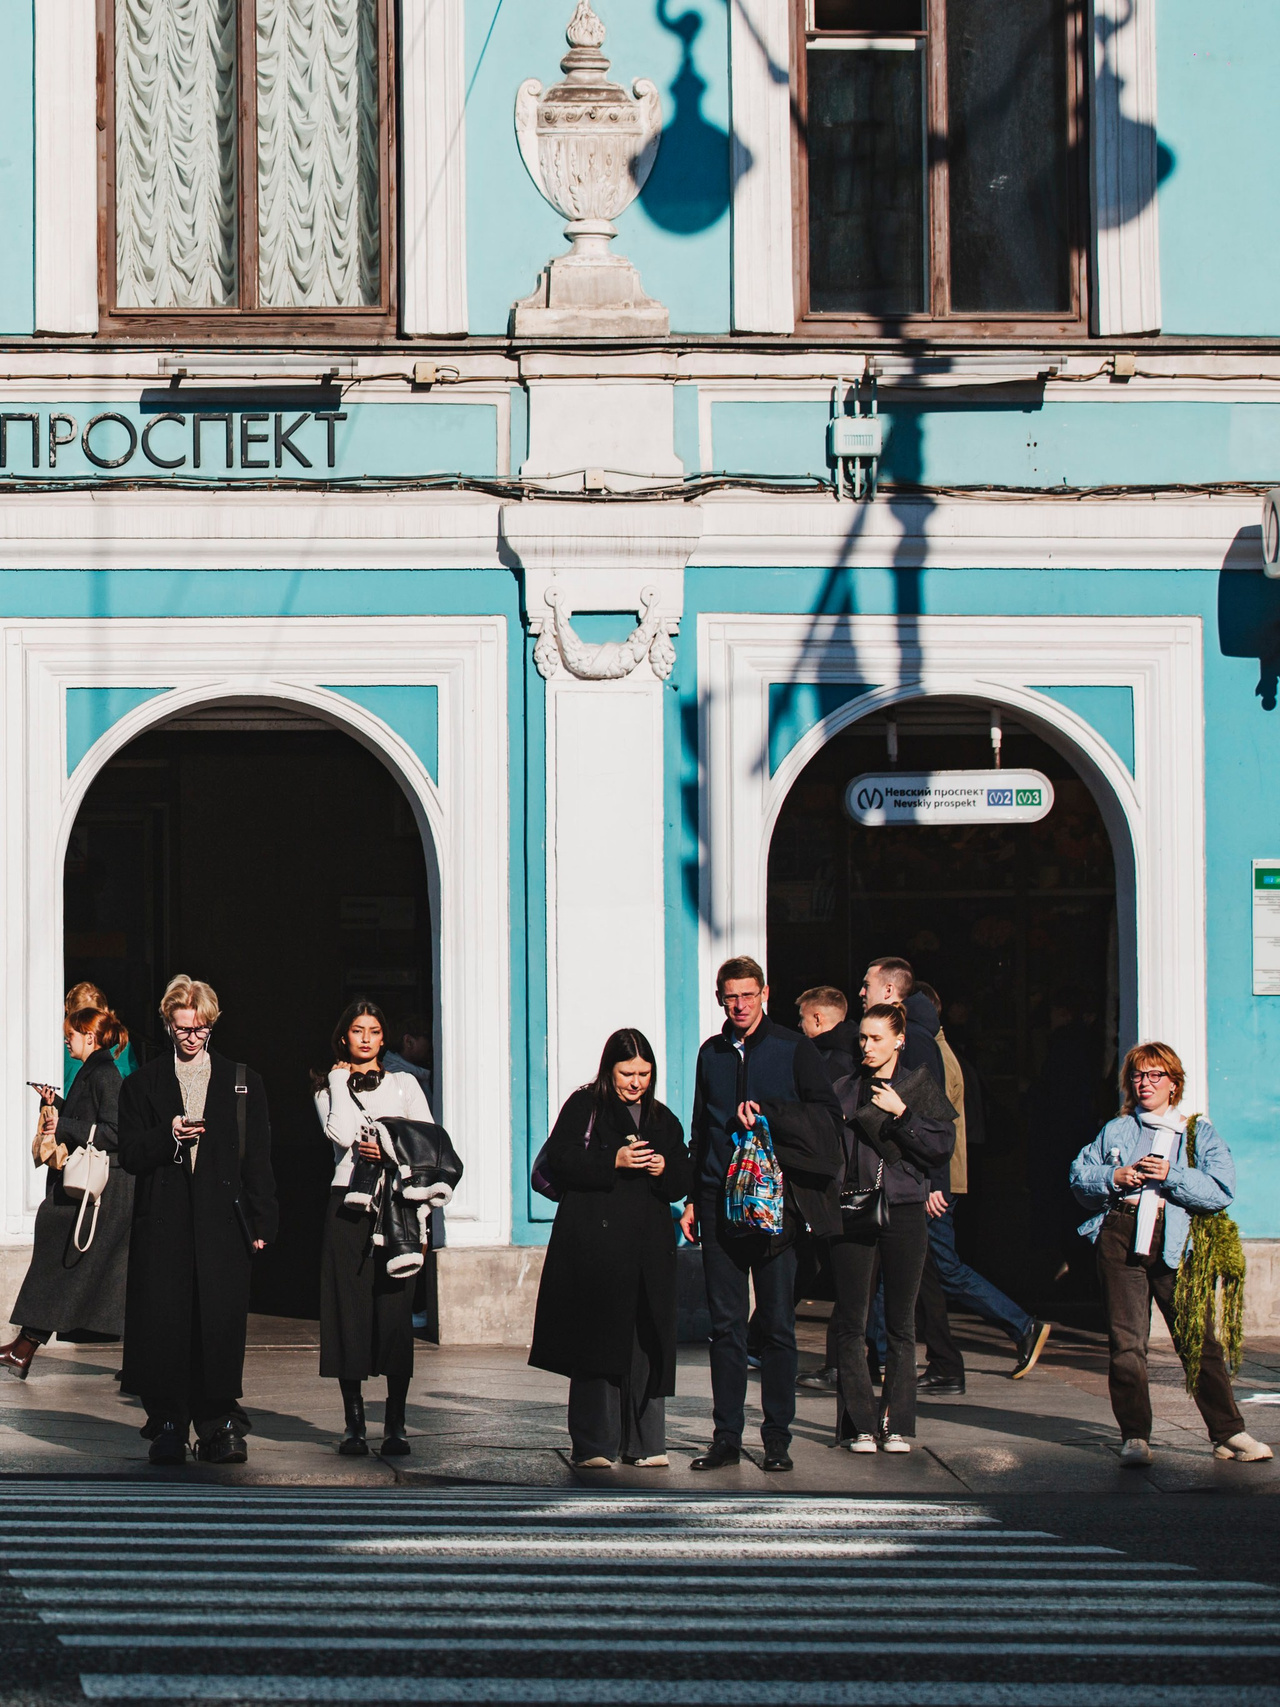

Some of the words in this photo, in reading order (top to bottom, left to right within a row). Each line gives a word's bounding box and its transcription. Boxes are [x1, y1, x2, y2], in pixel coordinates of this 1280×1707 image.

[0, 411, 348, 469] ПРОСПЕКТ
[885, 787, 932, 797] Невский
[934, 789, 984, 798] проспект
[894, 799, 931, 809] Nevskiy
[934, 799, 976, 809] prospekt
